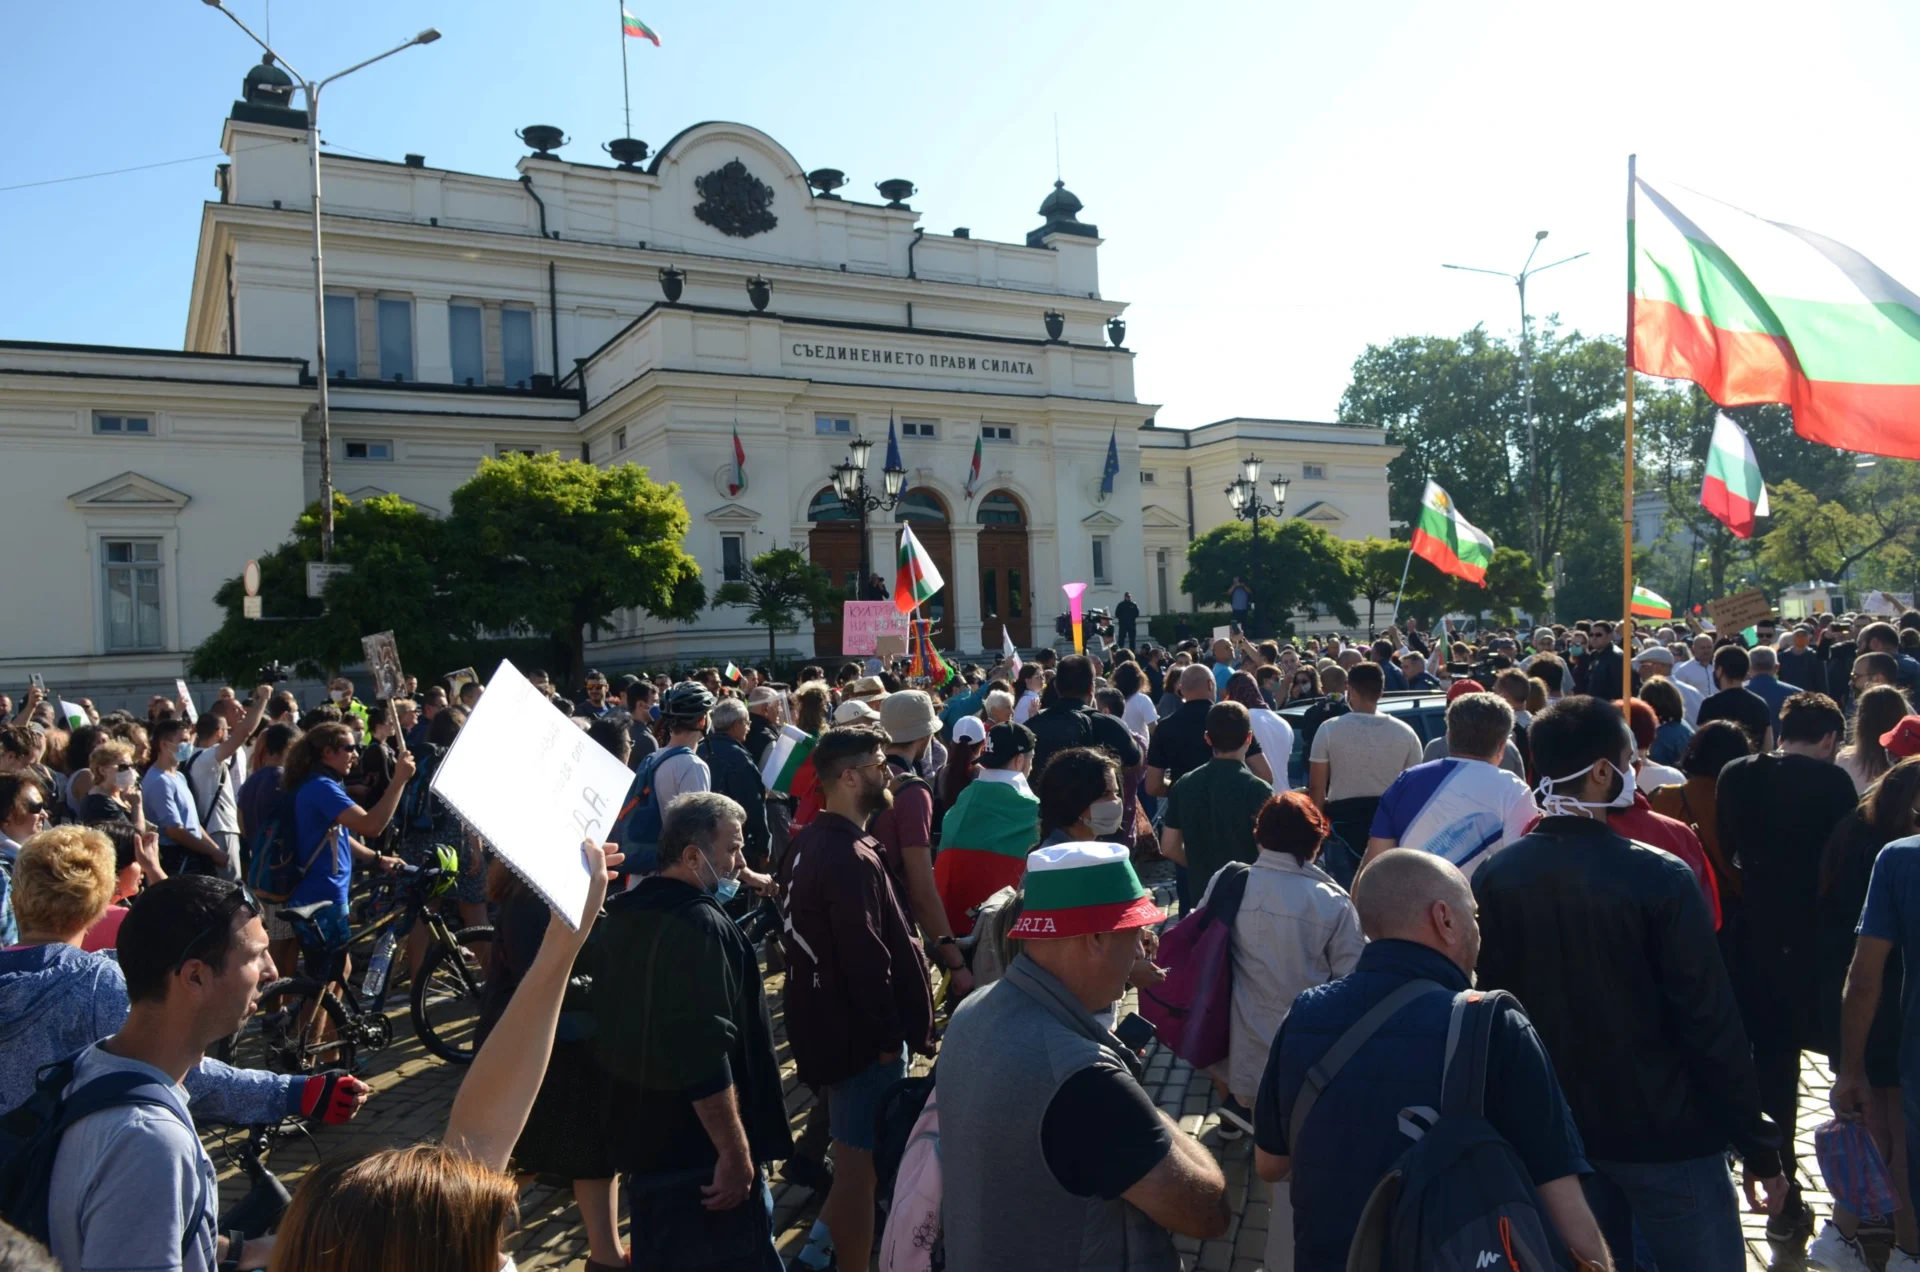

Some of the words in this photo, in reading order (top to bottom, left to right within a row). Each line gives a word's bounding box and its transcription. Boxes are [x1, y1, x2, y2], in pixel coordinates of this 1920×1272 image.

[793, 343, 925, 366] СЪЕДИНЕНИЕТО
[930, 354, 976, 370] ПРАВИ
[982, 358, 1034, 375] СИЛАТА
